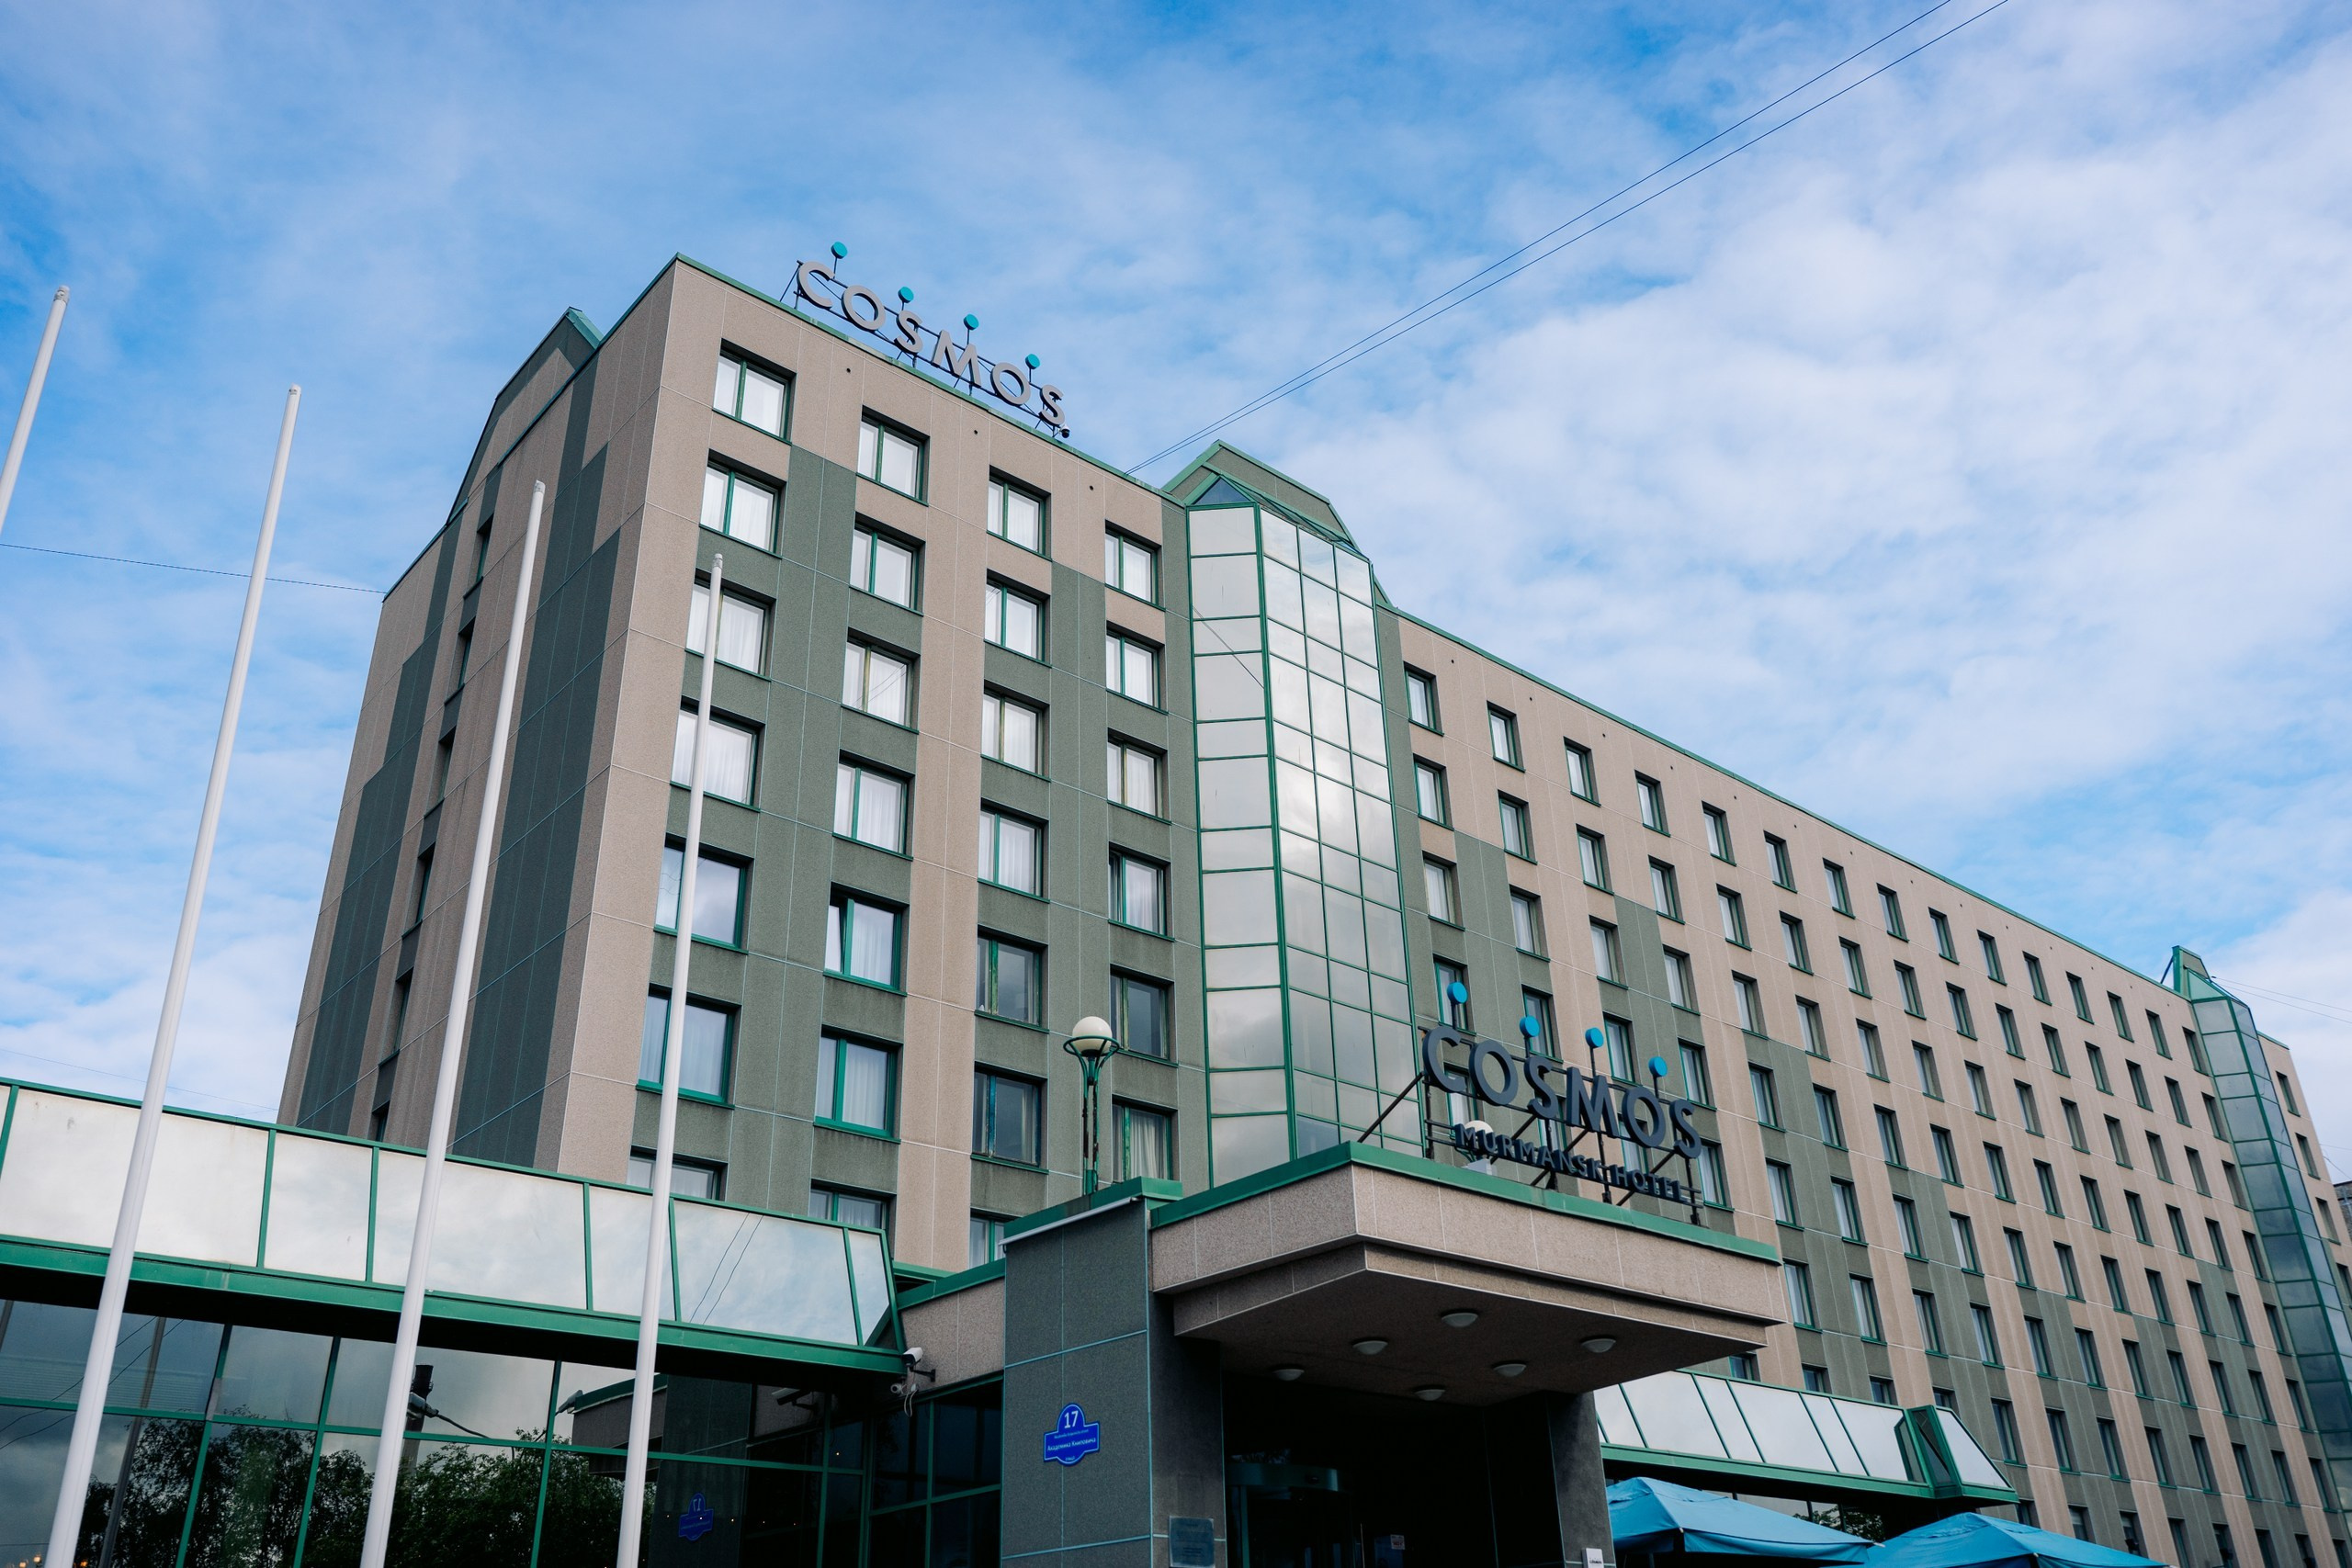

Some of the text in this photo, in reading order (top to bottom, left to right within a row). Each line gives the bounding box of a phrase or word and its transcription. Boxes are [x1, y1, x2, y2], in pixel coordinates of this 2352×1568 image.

[797, 261, 1066, 426] COSMOS
[1422, 1025, 1702, 1159] COSMOS
[1453, 1123, 1687, 1202] MURMANSK HOTEL
[1064, 1410, 1079, 1428] 17
